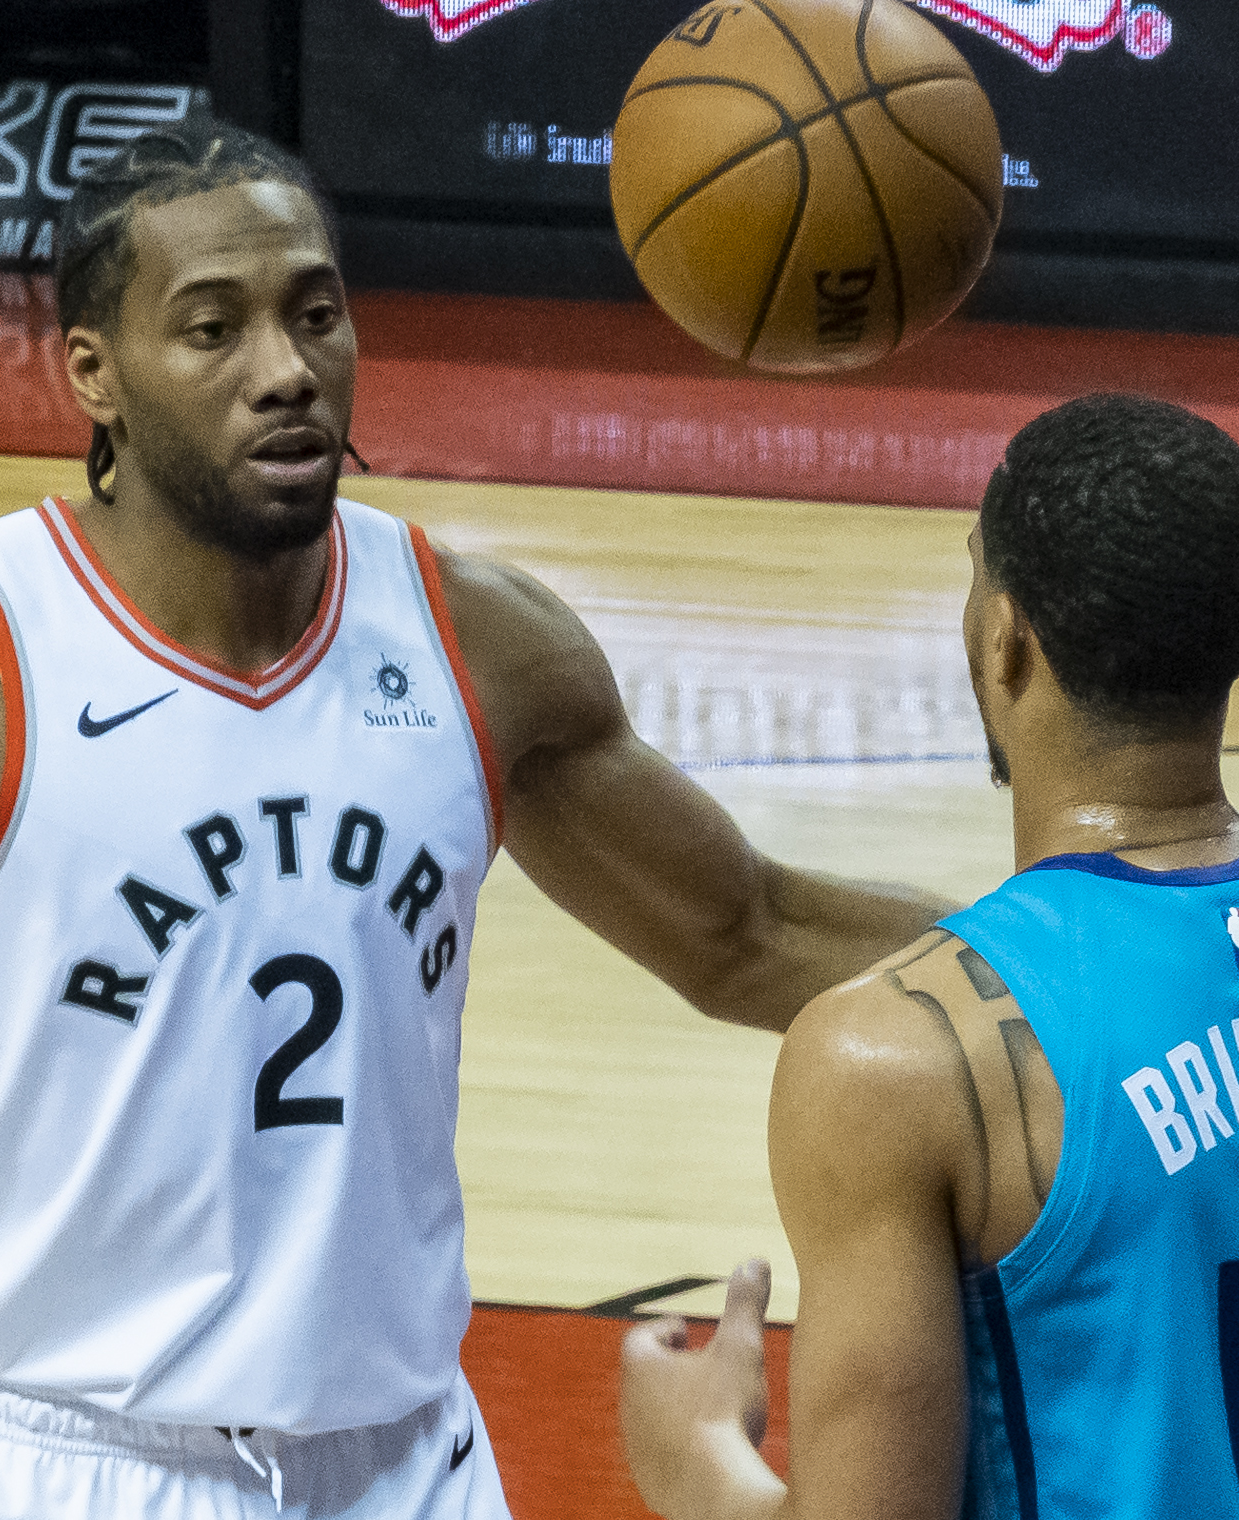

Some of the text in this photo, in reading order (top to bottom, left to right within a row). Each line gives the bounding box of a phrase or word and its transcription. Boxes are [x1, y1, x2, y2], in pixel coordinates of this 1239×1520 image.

[363, 708, 438, 728] Sun Life
[59, 795, 457, 1028] RAPTORS
[248, 952, 345, 1133] 2
[1121, 1018, 1239, 1176] BRI
